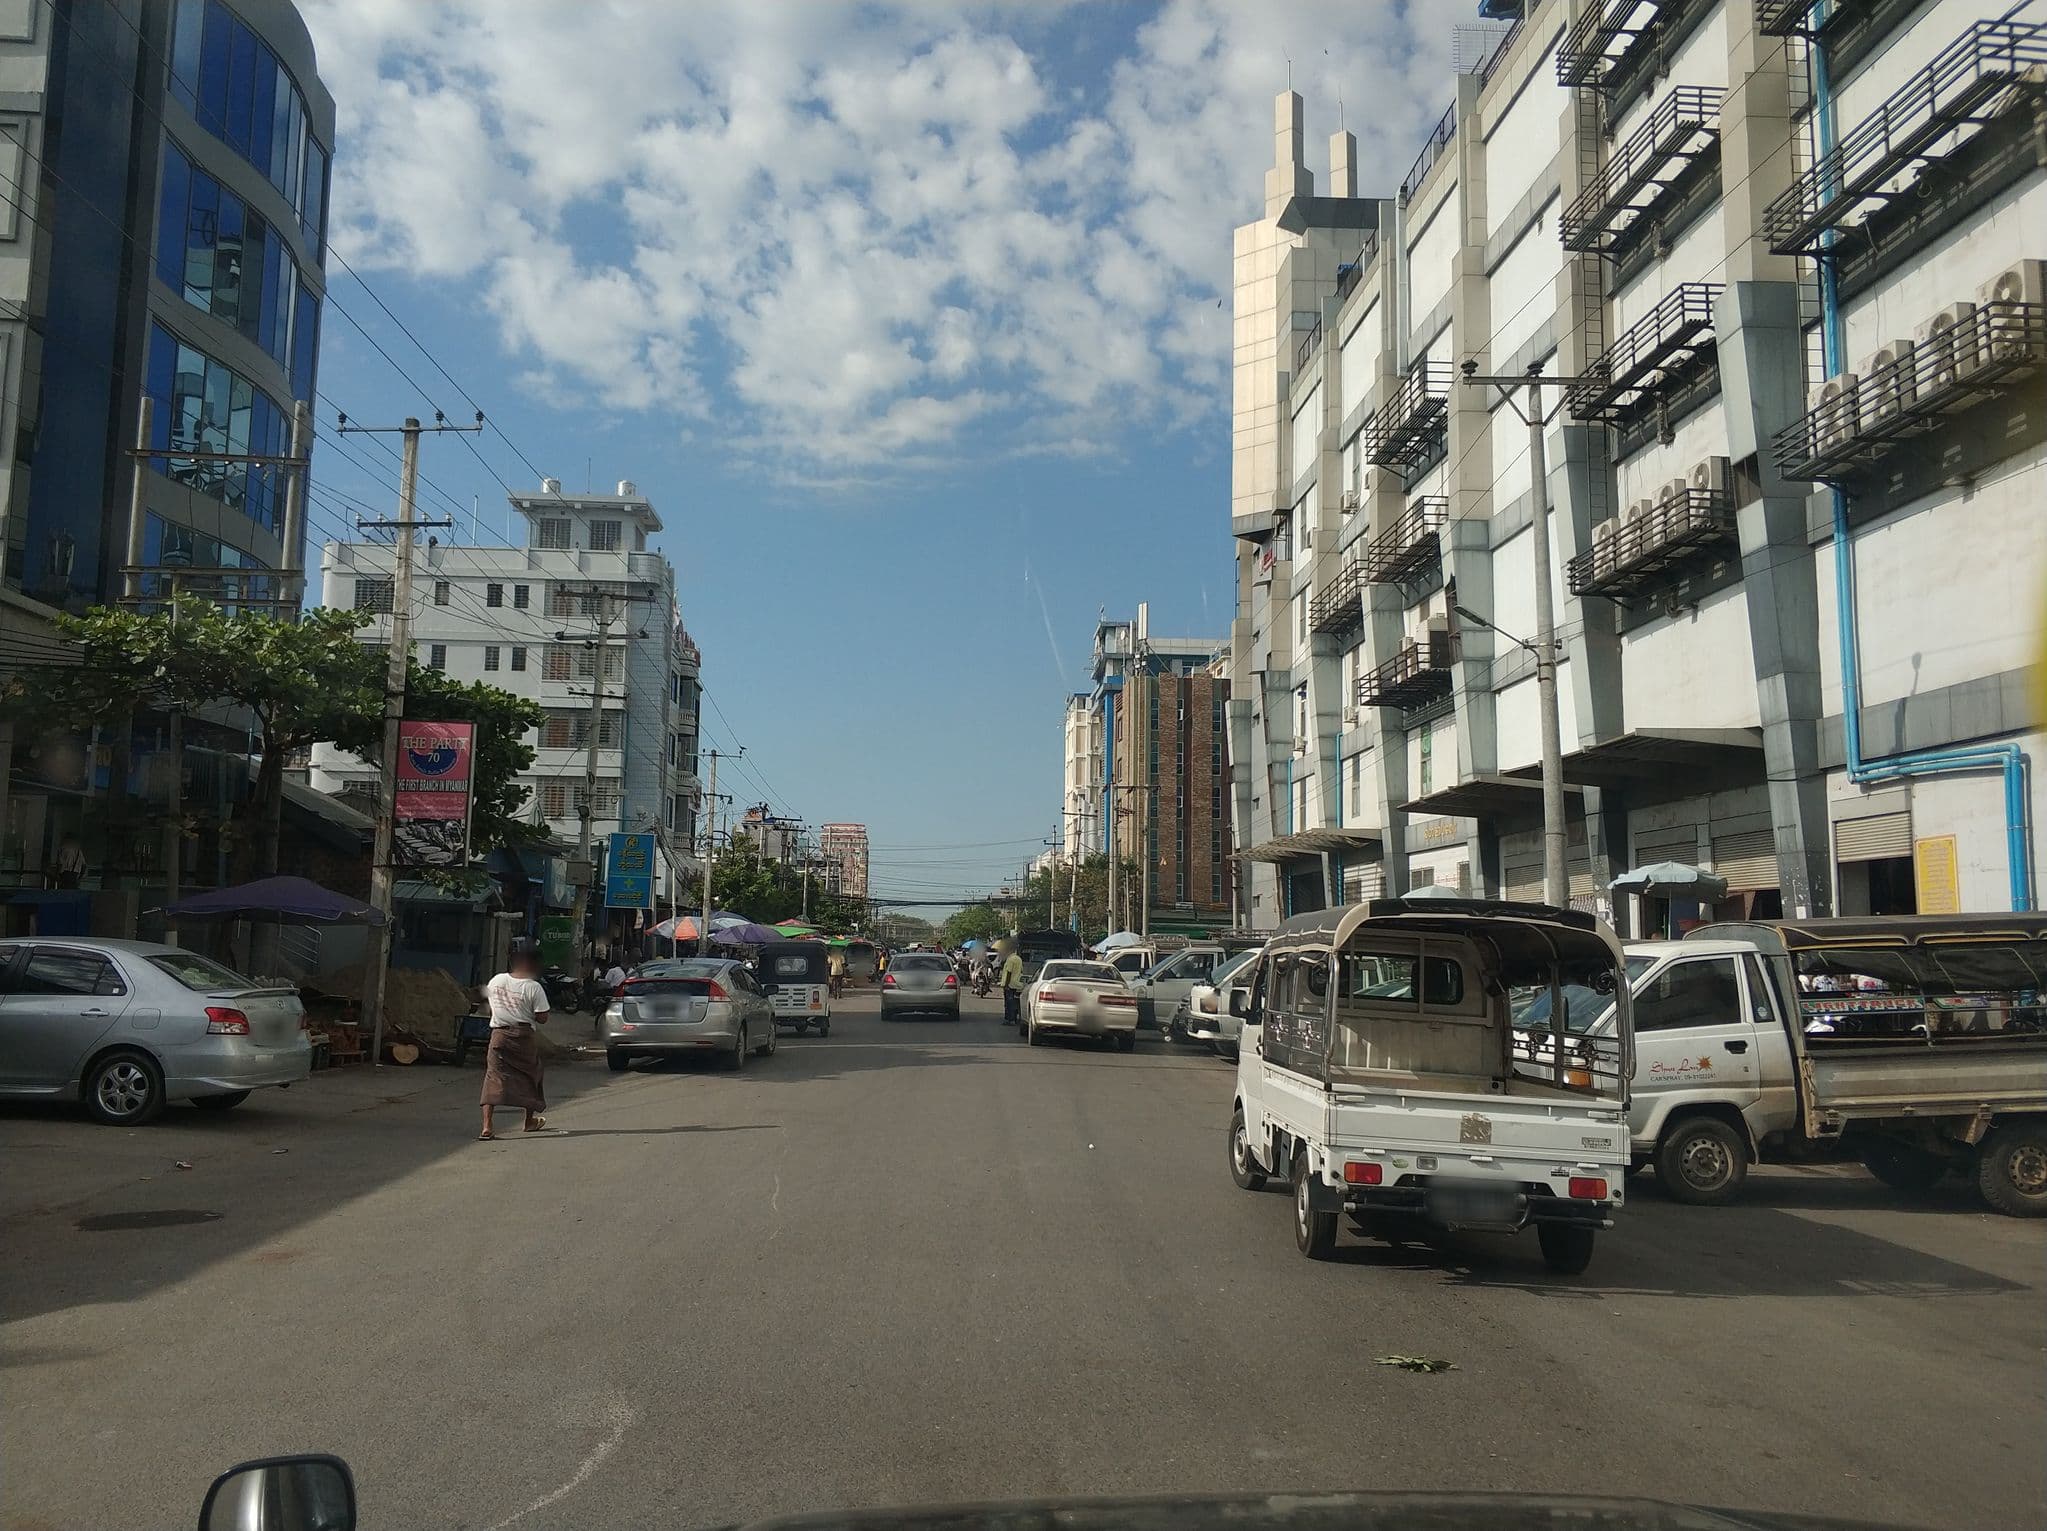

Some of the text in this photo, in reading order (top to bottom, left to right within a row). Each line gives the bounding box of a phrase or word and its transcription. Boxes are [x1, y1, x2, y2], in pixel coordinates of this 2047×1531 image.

[401, 736, 469, 751] THE PARTY
[427, 752, 440, 763] 70
[406, 779, 419, 791] FIRST
[420, 779, 438, 791] BRANCH
[446, 780, 468, 792] MYANMAR
